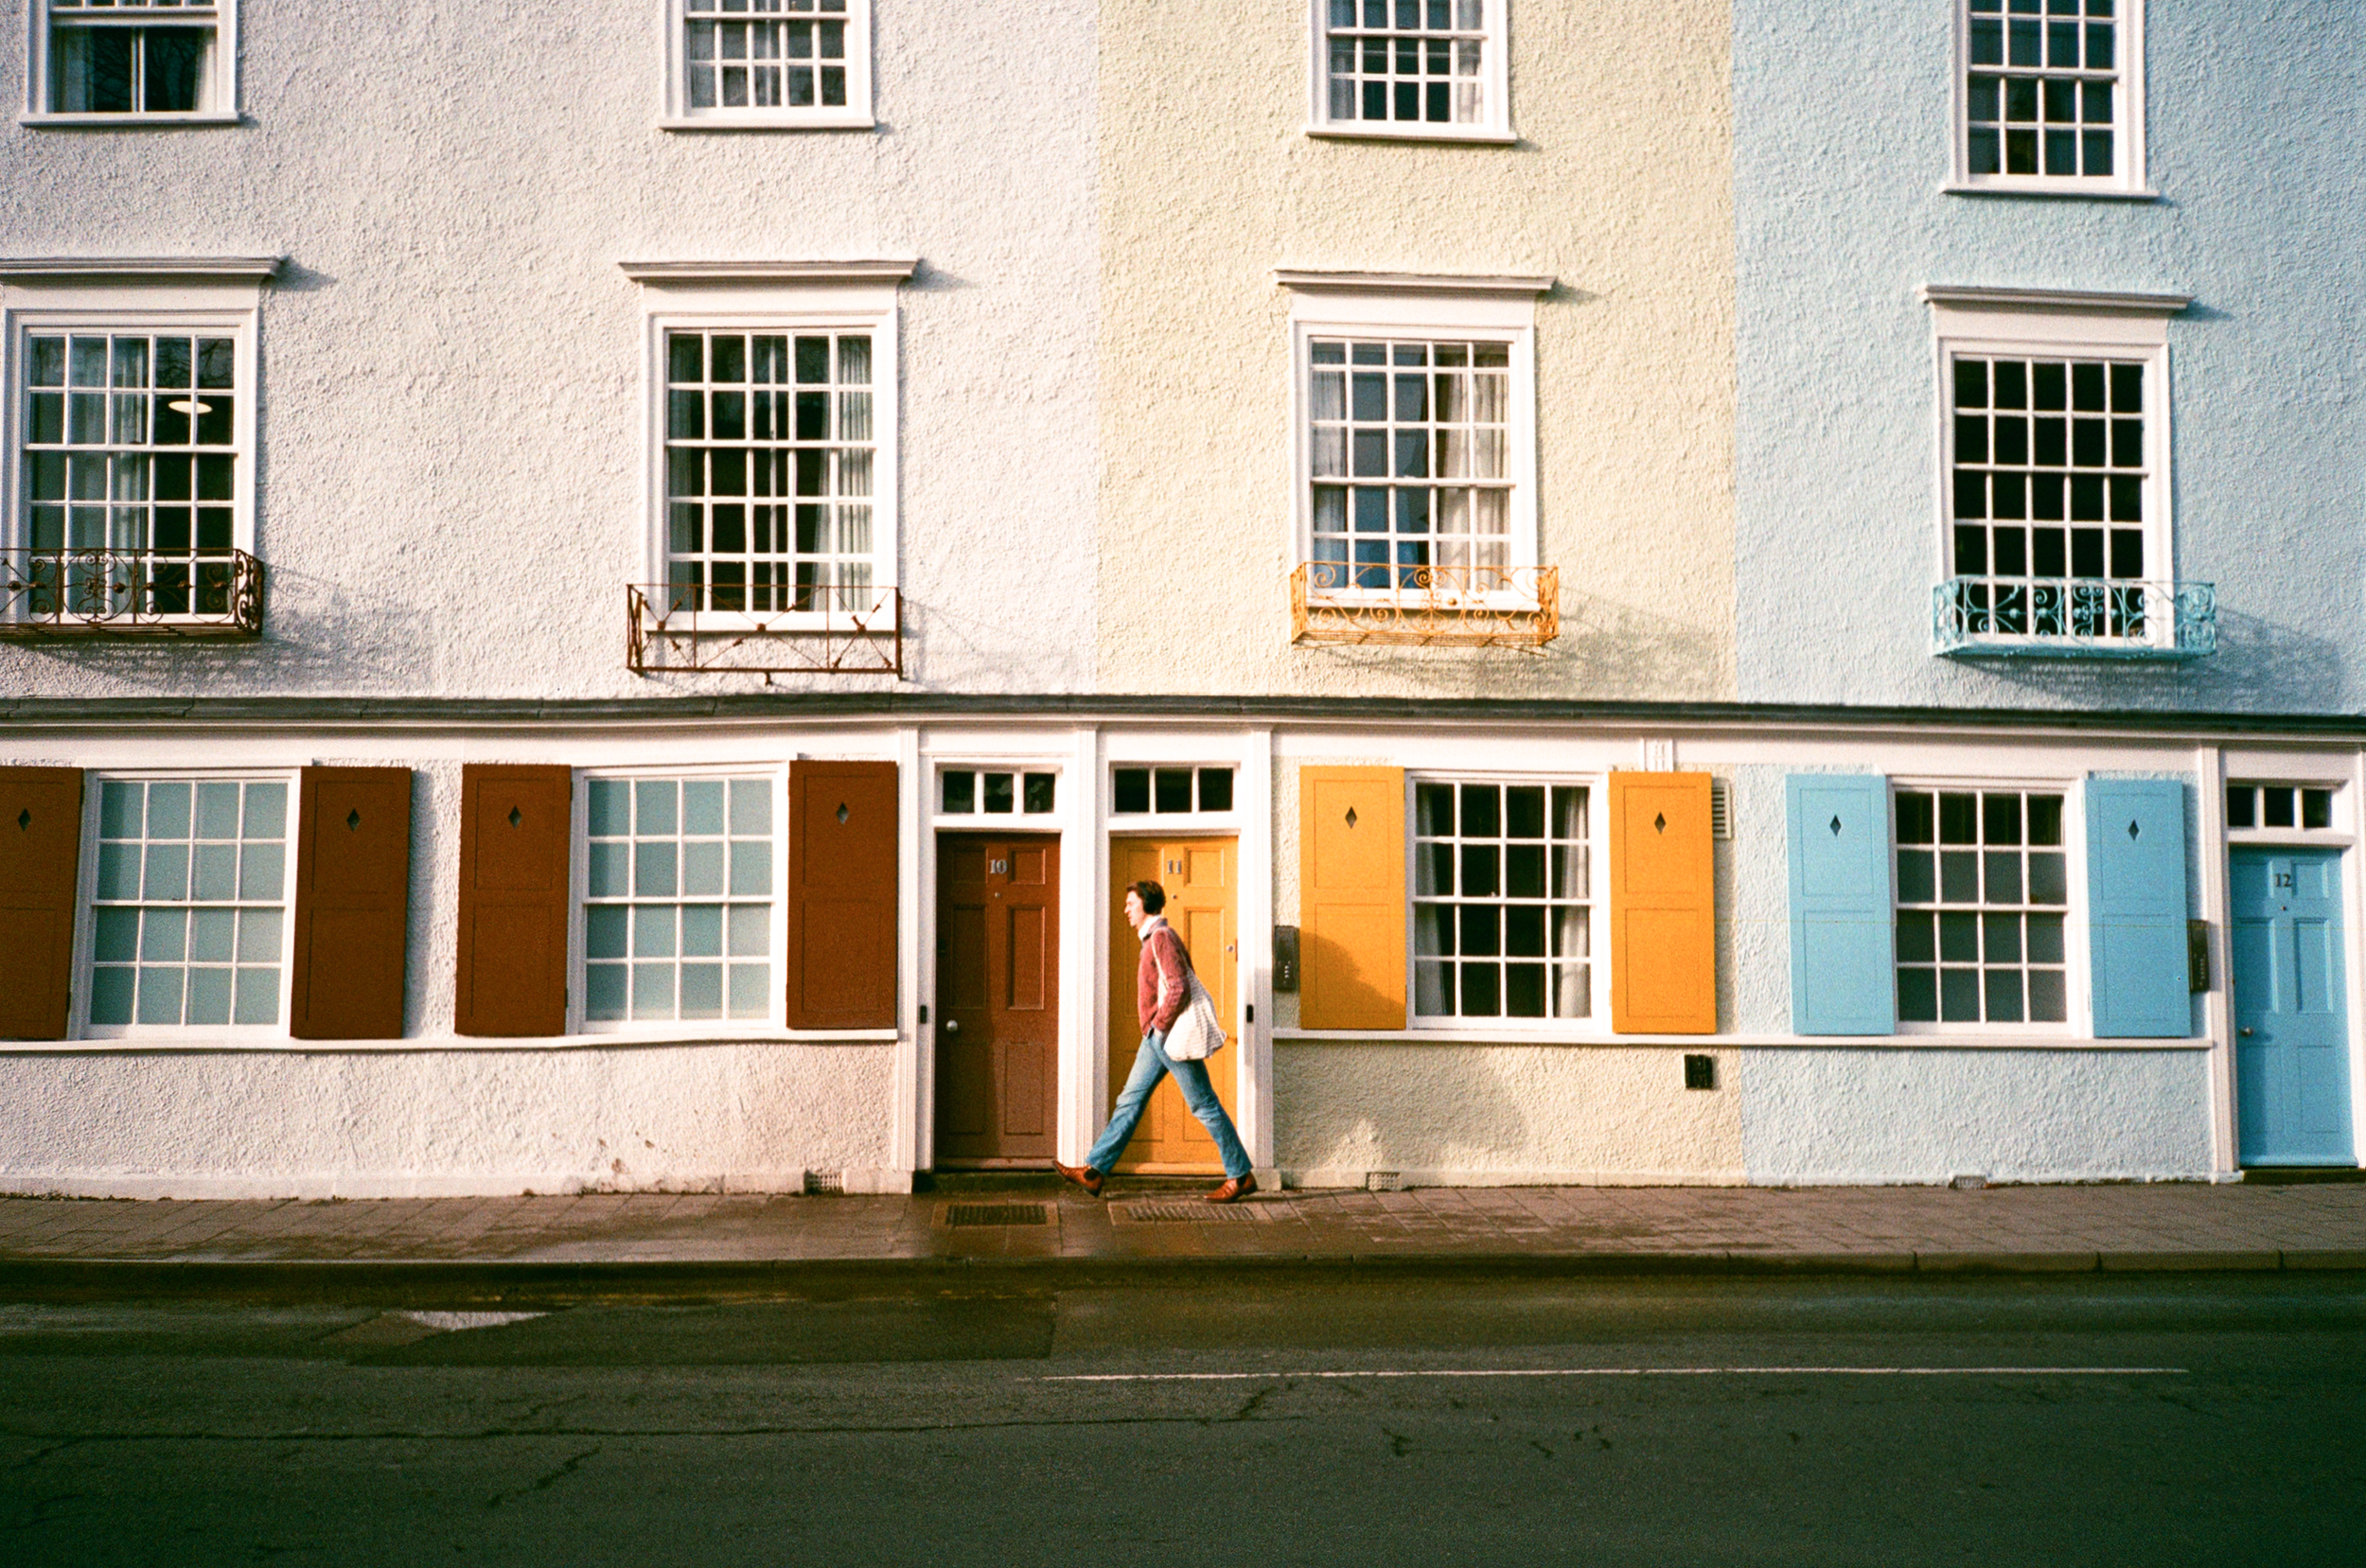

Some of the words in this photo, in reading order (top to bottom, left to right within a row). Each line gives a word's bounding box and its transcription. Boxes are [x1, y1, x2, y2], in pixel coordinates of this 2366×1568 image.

[989, 859, 1008, 874] 10
[1167, 860, 1182, 874] 11
[2274, 873, 2292, 888] 12
